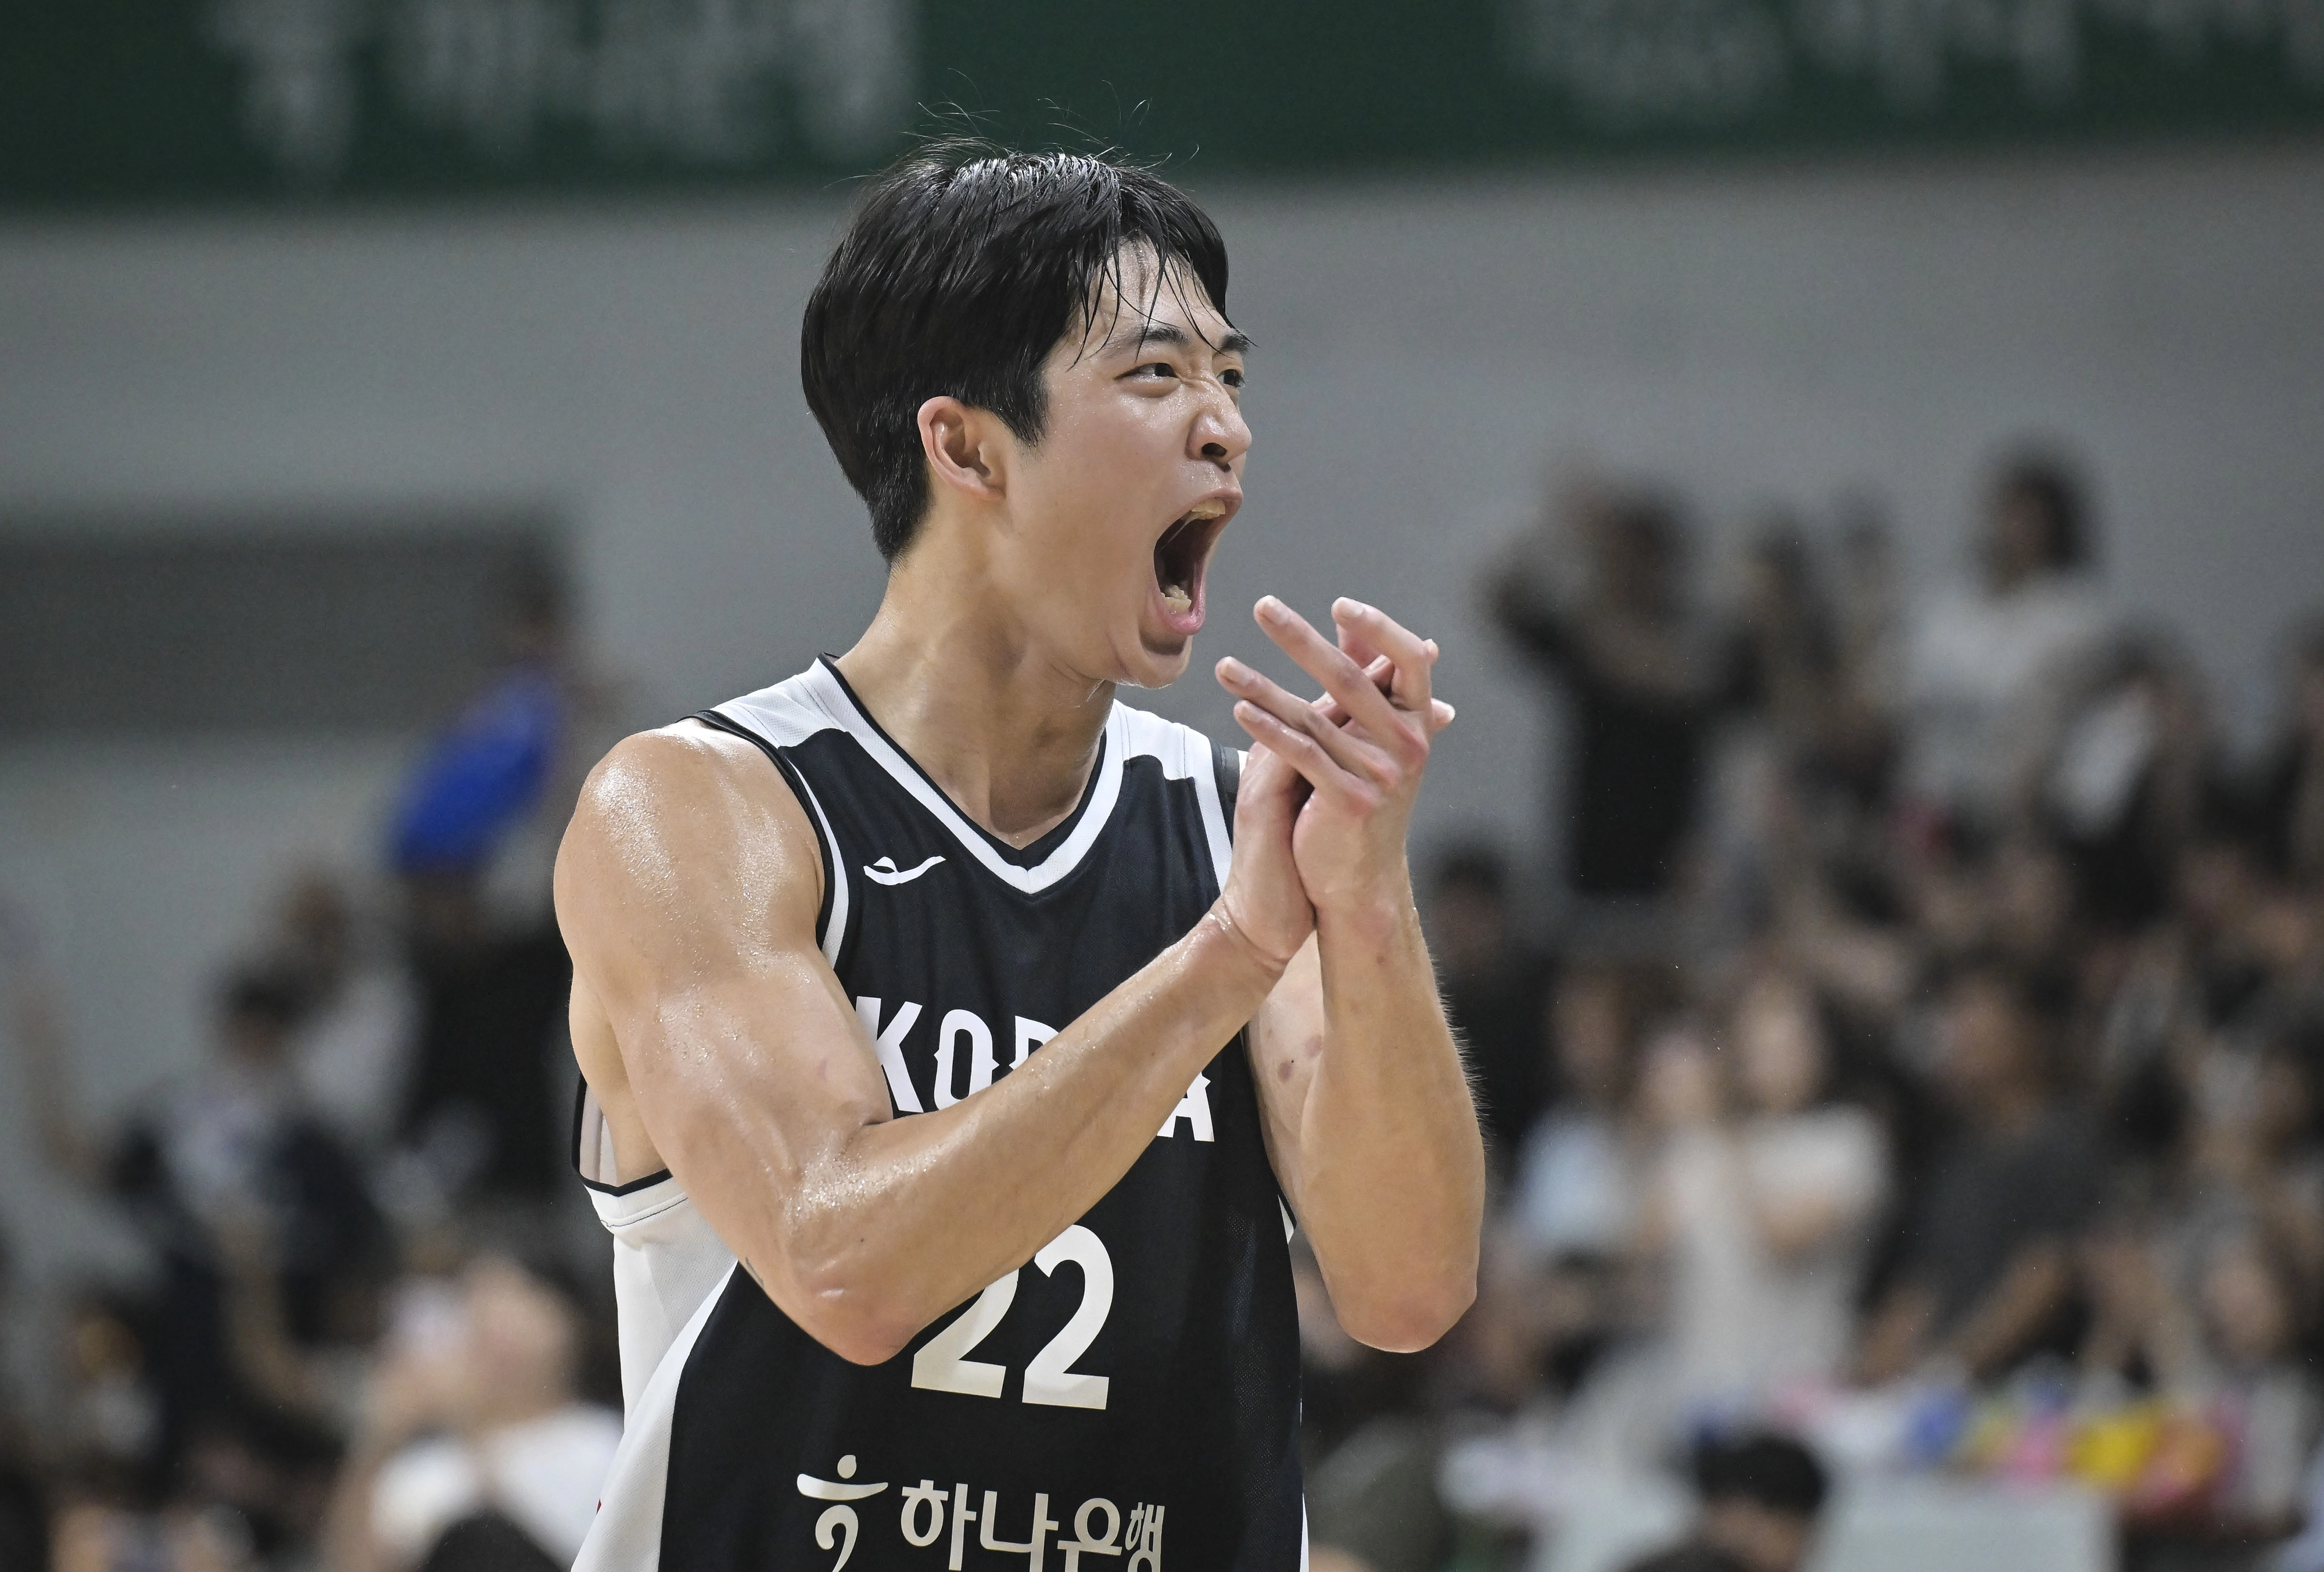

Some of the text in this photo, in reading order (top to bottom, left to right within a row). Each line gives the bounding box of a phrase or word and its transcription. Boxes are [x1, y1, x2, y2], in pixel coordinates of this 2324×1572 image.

[855, 996, 1215, 1142] KOA
[911, 1224, 1114, 1410] 22
[901, 1480, 1165, 1572] 하나은행
